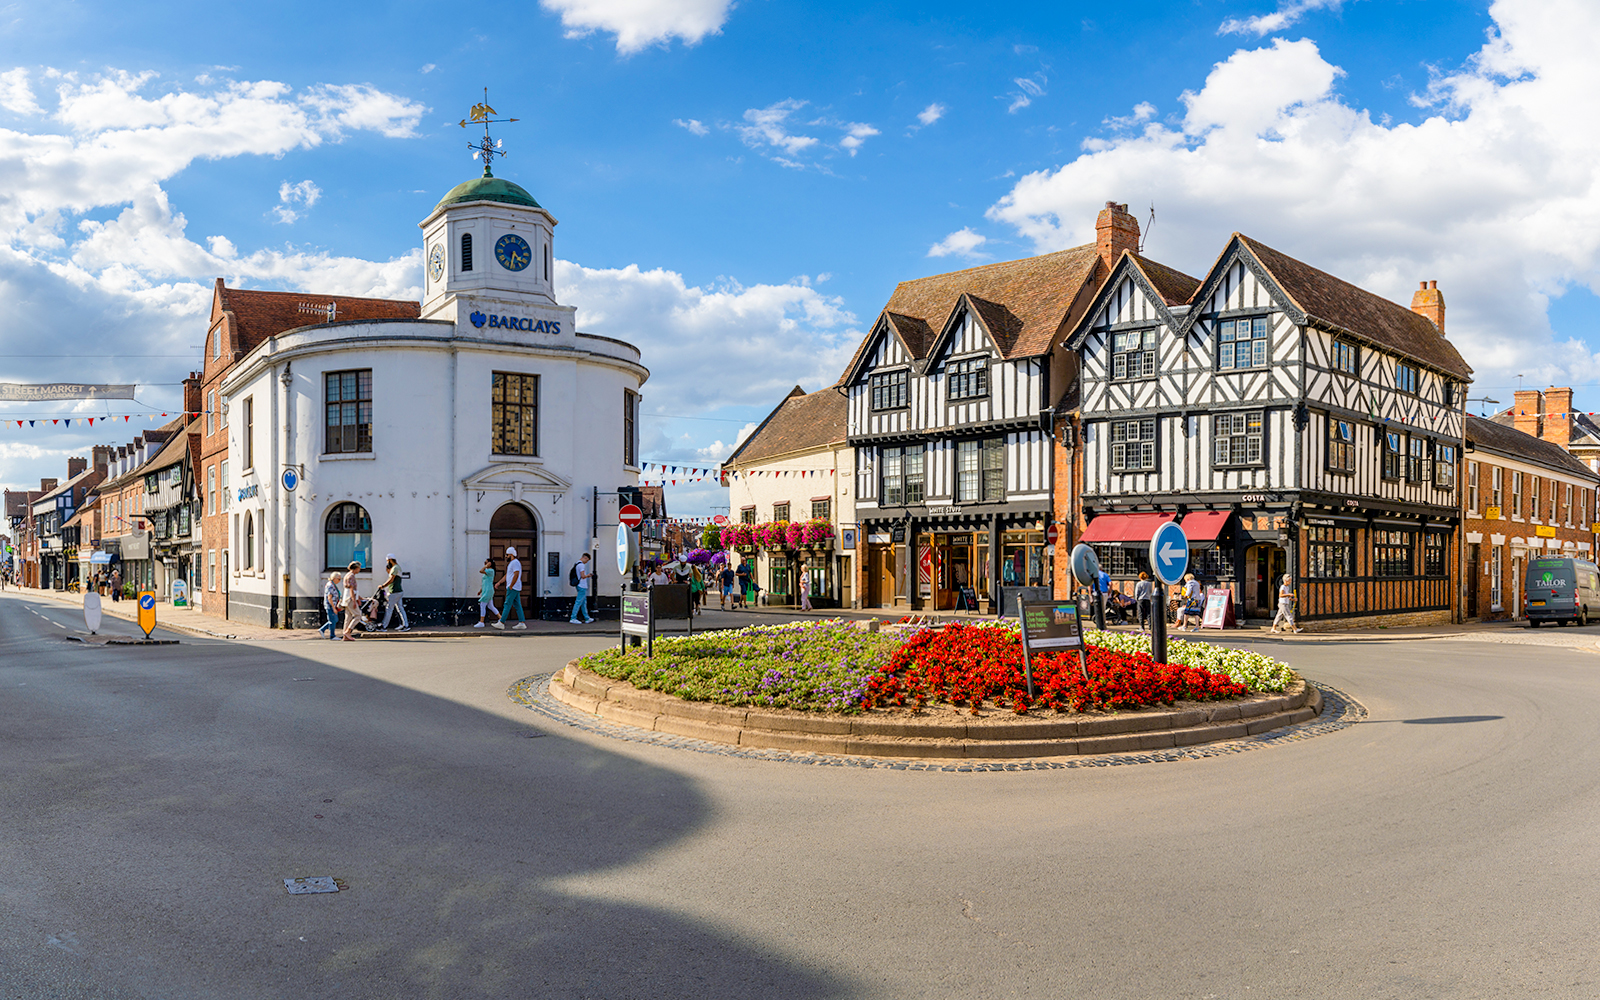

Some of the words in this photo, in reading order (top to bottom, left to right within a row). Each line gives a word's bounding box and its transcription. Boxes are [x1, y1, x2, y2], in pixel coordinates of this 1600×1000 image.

[489, 314, 561, 335] BARCLAYS
[2, 385, 40, 395] STREET
[40, 385, 85, 394] MARKET
[43, 392, 75, 400] SATURDAY
[946, 506, 962, 514] STUFF
[1535, 579, 1566, 587] TAILOR
